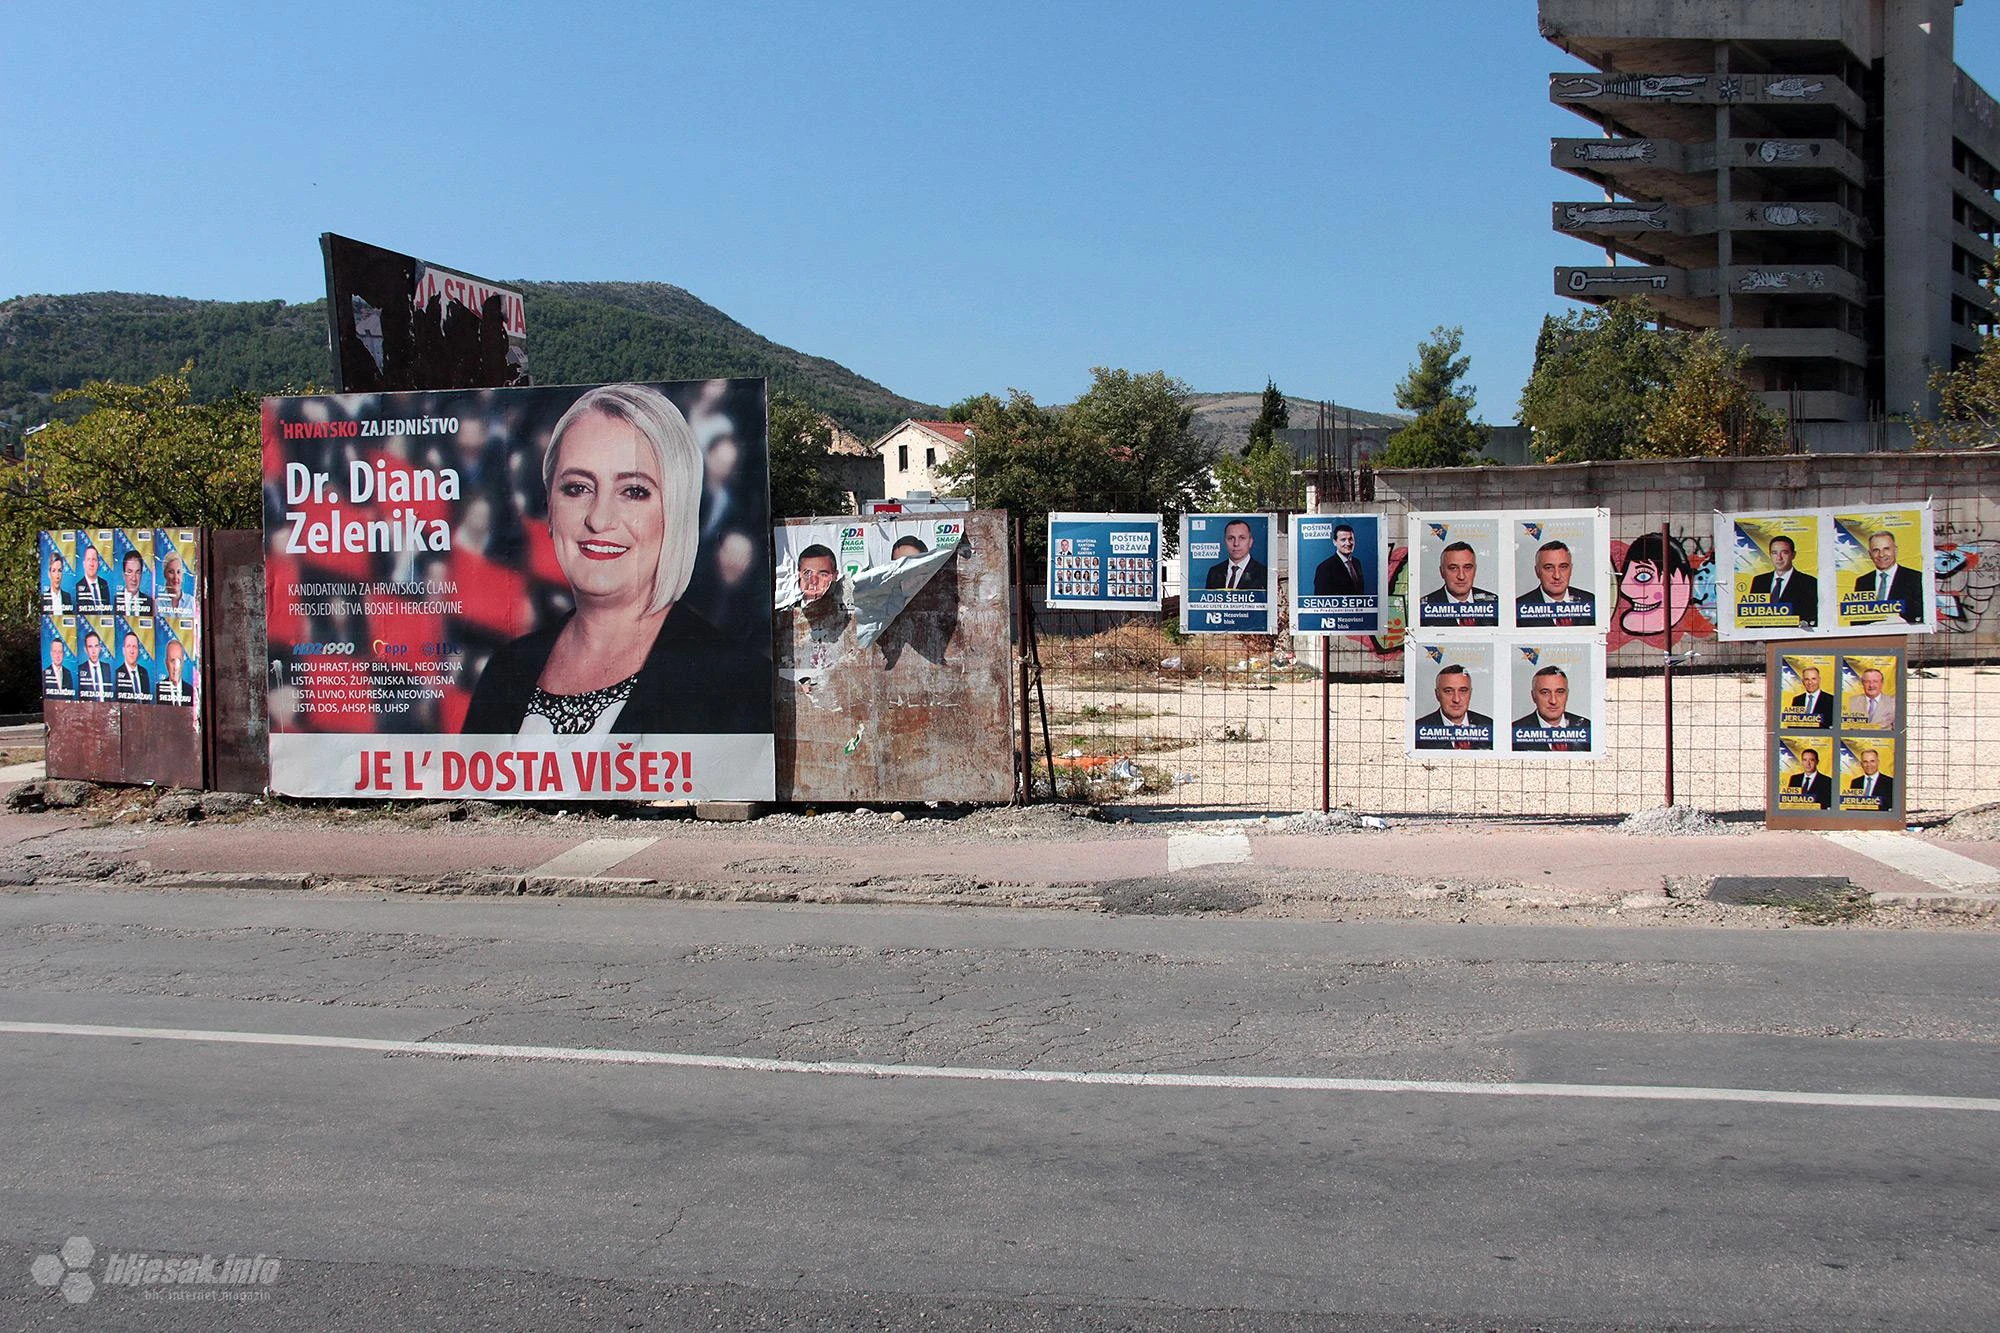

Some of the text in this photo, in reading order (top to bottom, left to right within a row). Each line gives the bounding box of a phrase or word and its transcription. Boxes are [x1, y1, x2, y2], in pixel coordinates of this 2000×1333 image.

[284, 415, 458, 439] HRVATSKO ZAJEDNIŠTVO
[286, 458, 460, 504] Dr. Diana
[286, 508, 451, 554] Zelenika
[841, 528, 864, 538] SDA
[936, 524, 960, 534] SDA
[1112, 534, 1150, 542] POŠTENA
[1114, 542, 1147, 550] DRŽAVA
[288, 580, 458, 596] KANDIDATKINJA ZA HRVATSKOG ČLANA
[1200, 592, 1255, 603] ADIS ŠEHIĆ
[1304, 596, 1374, 607] SENAD ŠEPIĆ
[1741, 594, 1766, 603] ADIS
[1843, 592, 1875, 601] AMER
[288, 600, 462, 616] PREDSJEDNIŠTVA BOSNE I HERCEGOVINE
[1460, 603, 1494, 613] RAMIĆ
[1556, 604, 1591, 613] RAMIĆ
[1741, 606, 1789, 616] BUBALO
[1843, 601, 1902, 614] JERLAGIĆ
[386, 643, 408, 655] epp
[291, 662, 462, 672] HKDU HRAST, HSP BiH, HNL, NEOVISNA
[291, 674, 454, 686] LISTA PRKOS, ŽUPANIJSKA NEOVISNA
[292, 688, 444, 700] LISTA LIVNO, KUPREŠKA NEOVISNA
[292, 704, 410, 713] LISTA DOS, AHSP, HB, UHSP
[1783, 714, 1821, 722] JERLAGIĆ
[1455, 726, 1489, 736] RAMIĆ
[1552, 728, 1586, 738] RAMIĆ
[355, 751, 392, 792] JE
[442, 750, 564, 792] DOSTA
[571, 742, 692, 793] VIŠE?!
[1842, 797, 1881, 805] JERLAGIĆ
